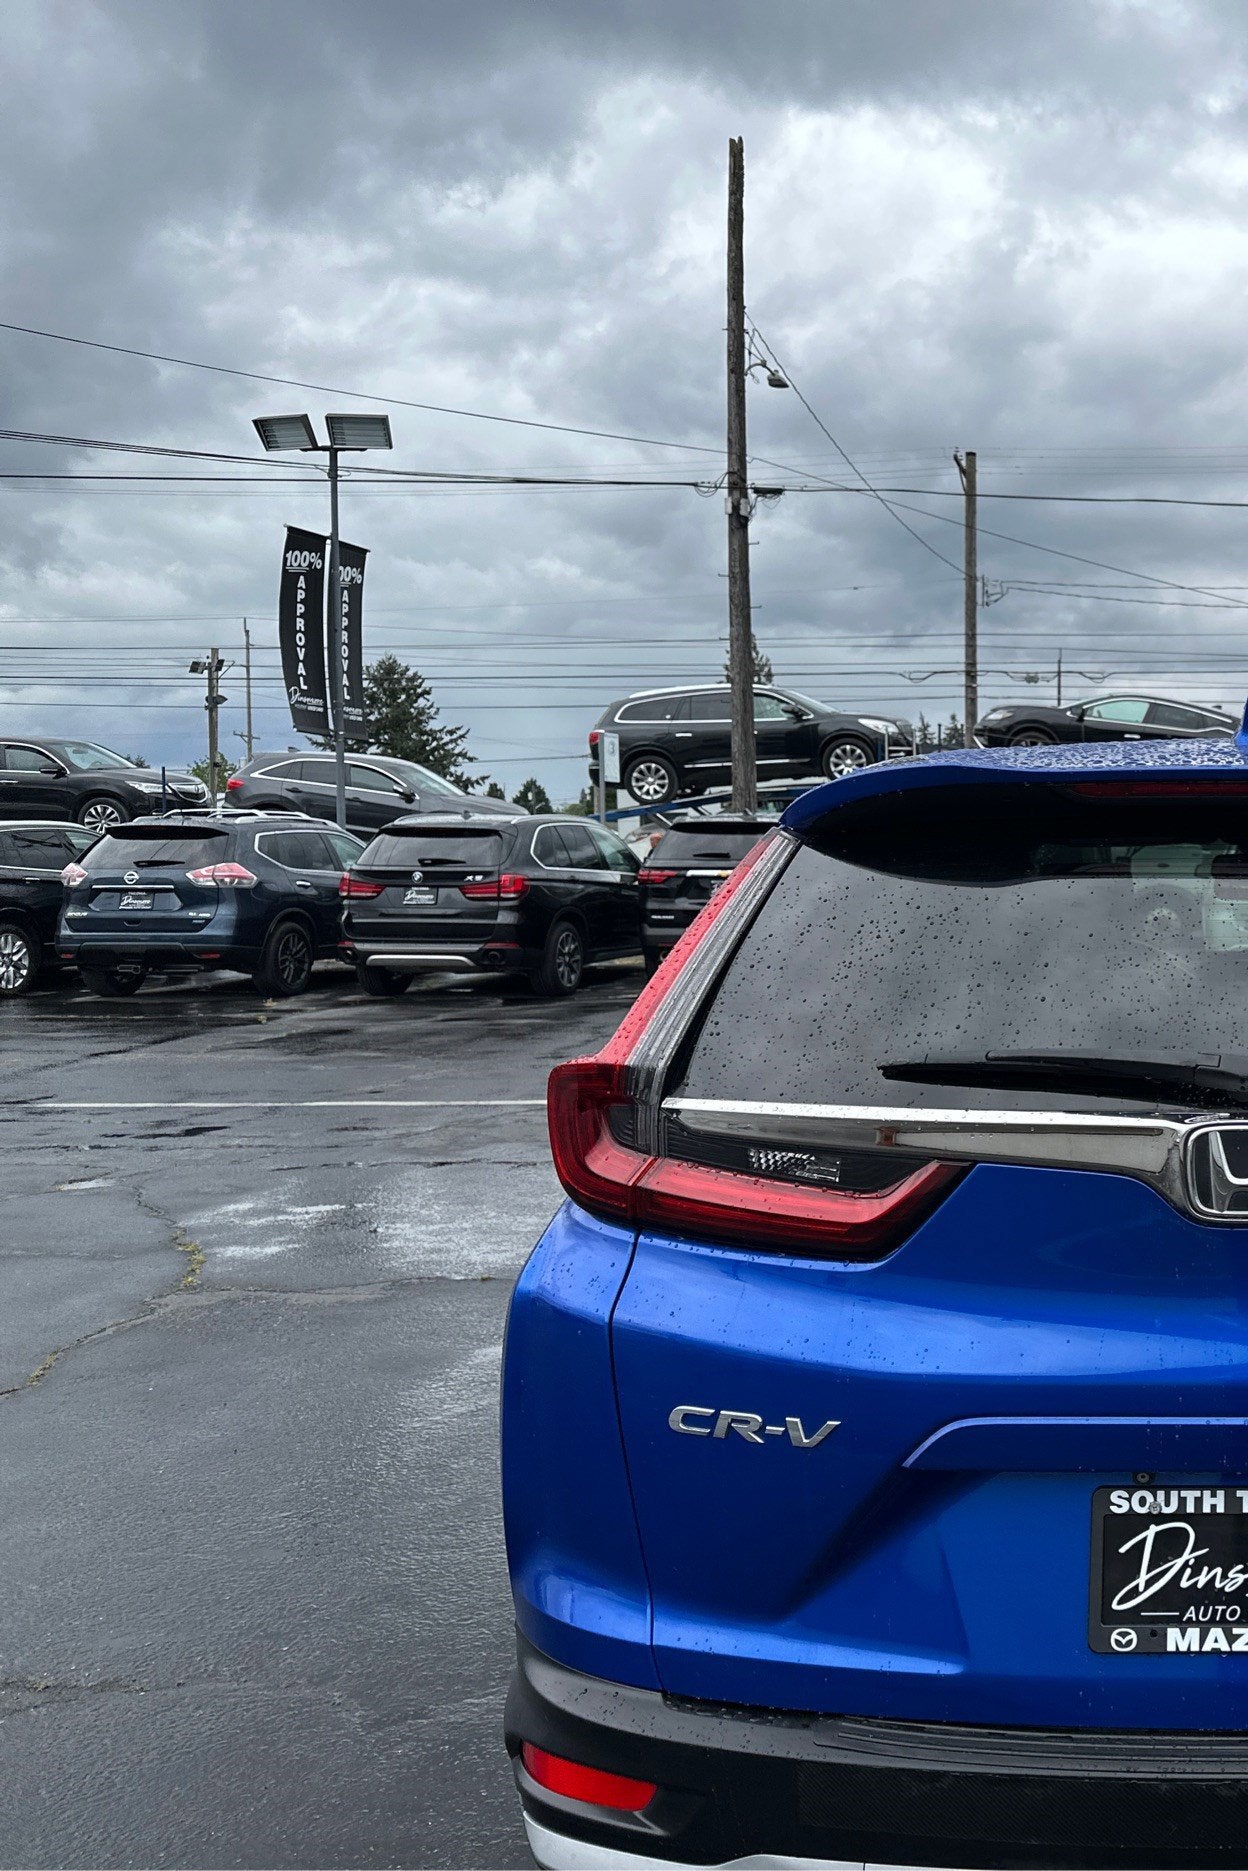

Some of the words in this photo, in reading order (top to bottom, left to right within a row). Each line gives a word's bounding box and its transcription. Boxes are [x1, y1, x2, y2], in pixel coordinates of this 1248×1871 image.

[285, 550, 323, 570] 100%
[295, 575, 308, 691] APPROVAL
[340, 589, 351, 700] APPROVAL
[668, 1405, 842, 1448] CR-V
[1109, 1490, 1225, 1514] SOUTH
[1183, 1605, 1241, 1622] AUTO
